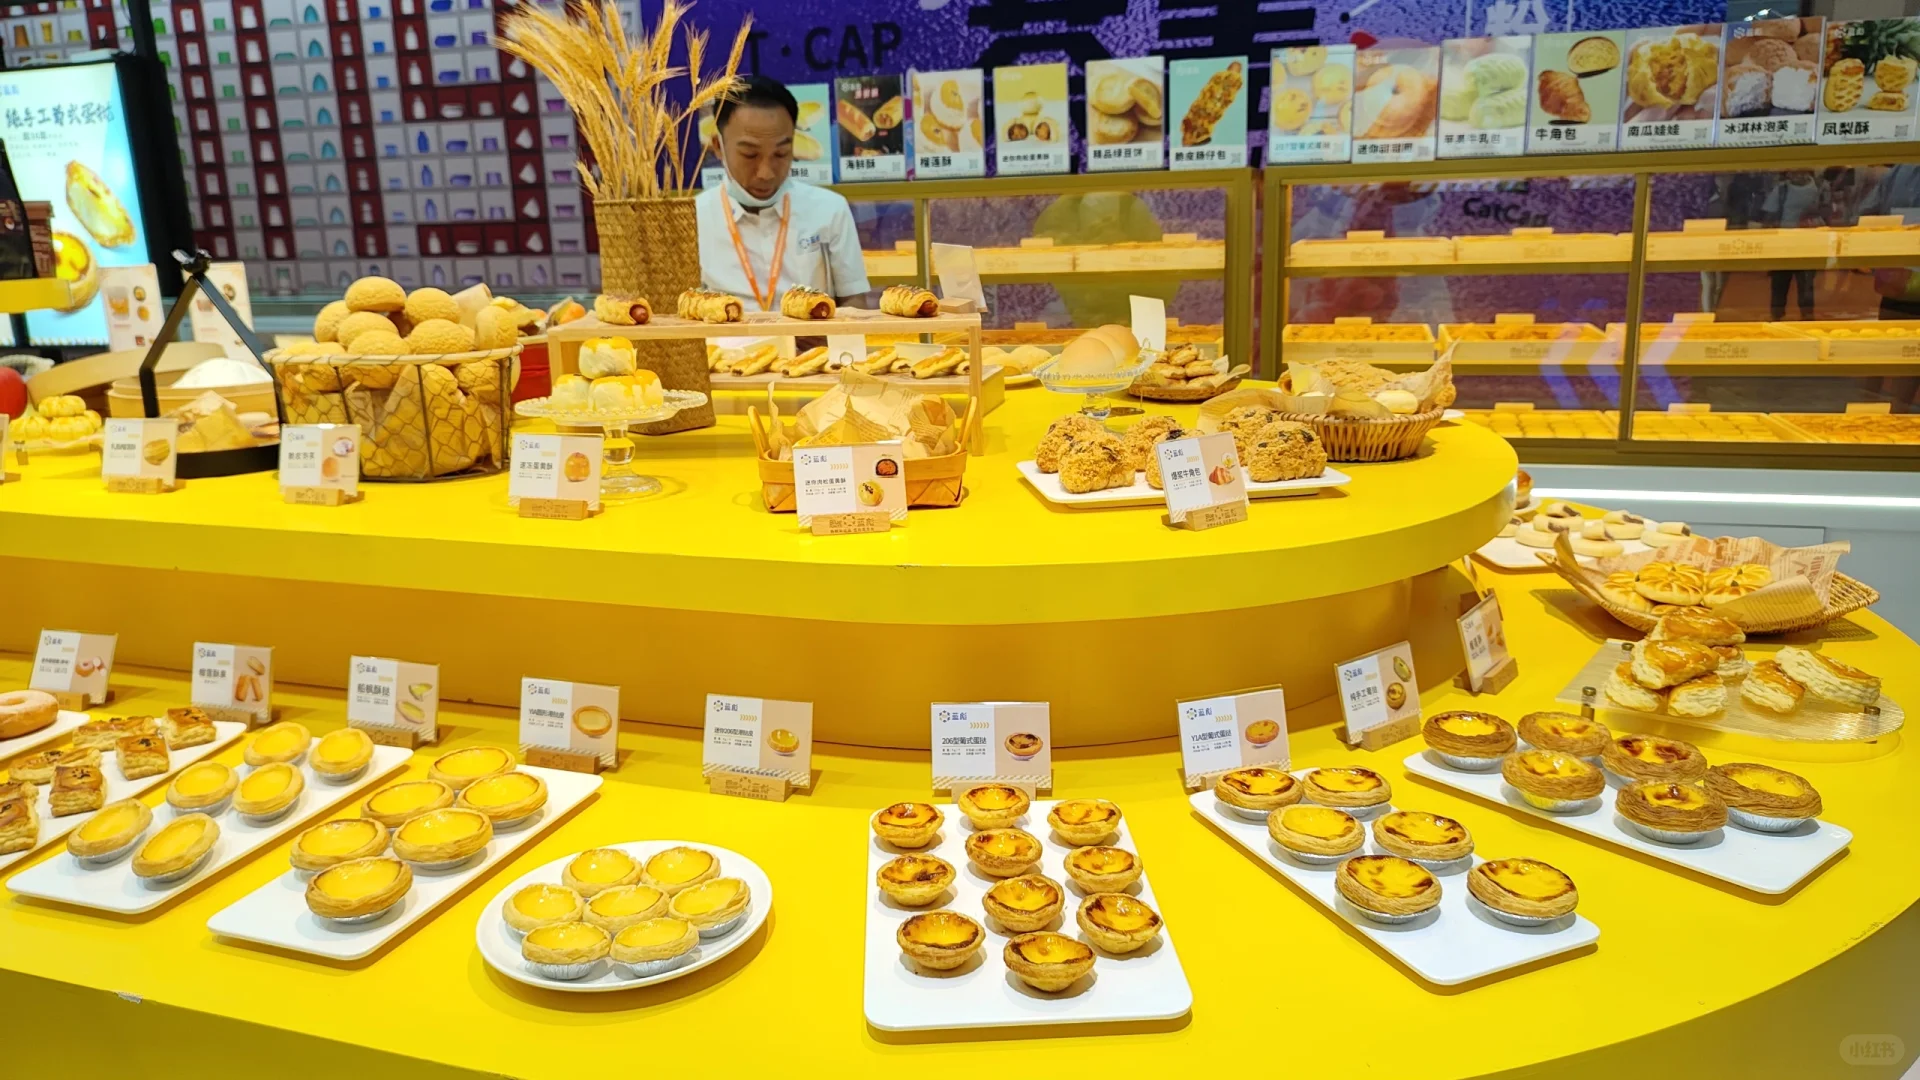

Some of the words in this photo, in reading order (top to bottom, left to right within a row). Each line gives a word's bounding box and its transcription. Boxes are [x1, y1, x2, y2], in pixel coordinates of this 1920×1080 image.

[1535, 128, 1577, 141] 牛角包
[1627, 123, 1681, 137] 南瓜娃娃
[1822, 120, 1870, 136] 凤梨酥
[920, 156, 952, 168] 榴莲酥
[1170, 467, 1202, 481] 爆浆牛角包
[941, 736, 987, 746] 206型葡式蛋挞
